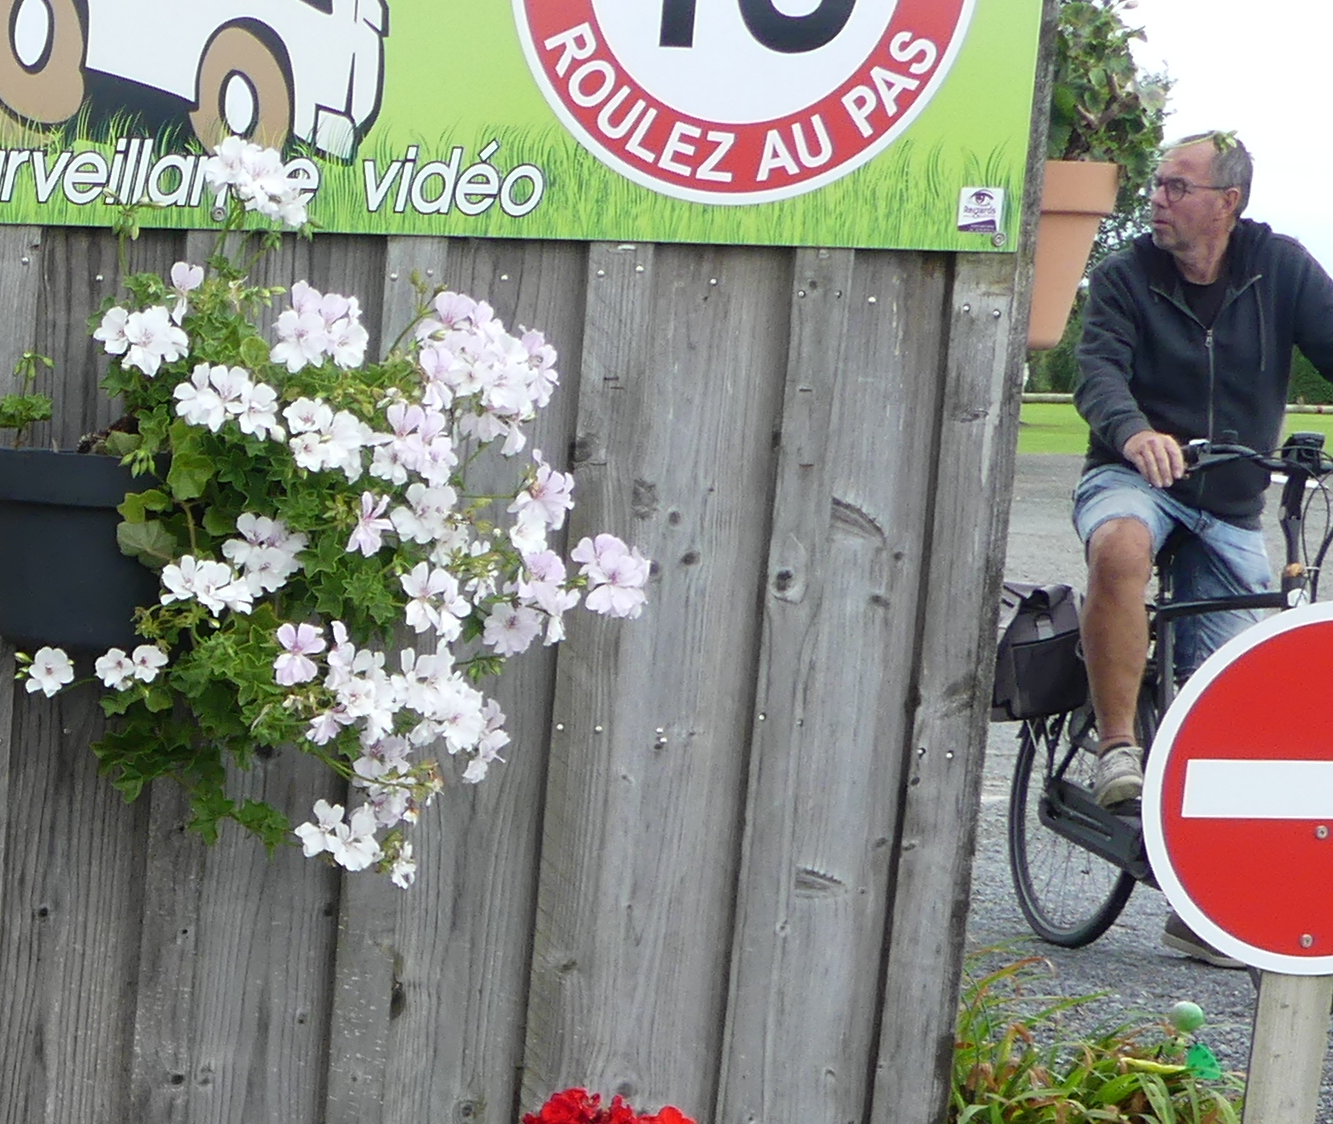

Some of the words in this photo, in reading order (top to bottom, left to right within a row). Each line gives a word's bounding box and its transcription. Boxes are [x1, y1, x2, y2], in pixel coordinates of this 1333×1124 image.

[543, 21, 736, 183] ROULEZ
[756, 114, 833, 182] AU
[841, 31, 938, 139] PAS
[362, 137, 546, 219] vidéo
